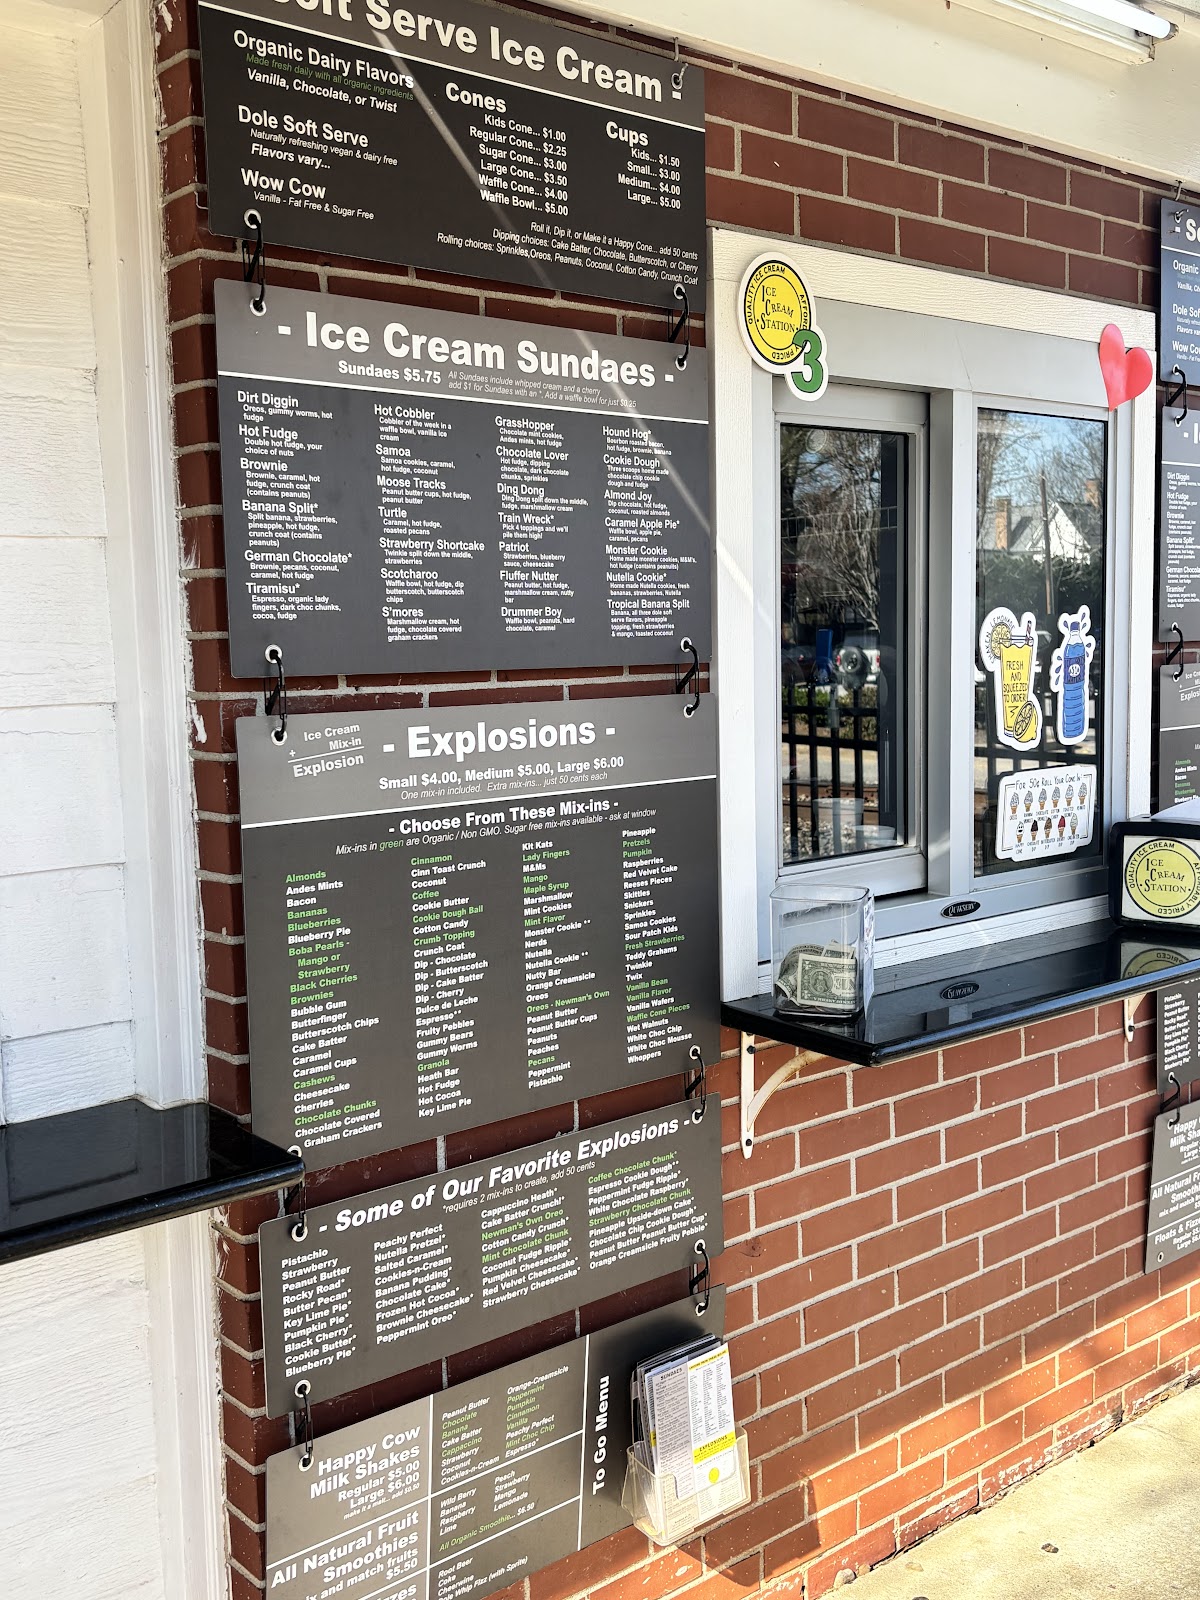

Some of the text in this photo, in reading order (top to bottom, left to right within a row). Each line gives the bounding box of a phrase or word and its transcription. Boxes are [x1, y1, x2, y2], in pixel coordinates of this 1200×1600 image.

[234, 30, 414, 88] Organic Dairy Flavors
[366, 0, 661, 102] Serve Ice Cream
[446, 82, 506, 113] Cones
[238, 105, 368, 147] Dole Soft Serve
[485, 114, 566, 142] Kids Cone... $1.00
[606, 121, 648, 147] Cups
[251, 128, 398, 166] Naturally refreshing vegan & dairy free
[631, 148, 680, 167] Kids... $1.50
[241, 168, 326, 199] Wow Cow
[493, 228, 520, 244] Dipping
[521, 234, 549, 247] choices:
[551, 239, 569, 250] Cake
[570, 242, 591, 255] Batter,
[593, 246, 627, 261] Chocolate,
[629, 252, 668, 268] Butterscotch,
[678, 261, 698, 274] Cherry
[1173, 260, 1199, 275] Organic
[762, 285, 776, 302] ICE
[766, 299, 794, 318] CREAM
[1172, 304, 1188, 316] Dole
[761, 313, 795, 333] STATION
[306, 311, 655, 387] Ice Cream Sundaes
[1172, 341, 1189, 353] Wow
[791, 329, 823, 393] 3
[338, 360, 441, 384] Sundaes $5.75
[238, 391, 298, 408] Dirt Diggin
[243, 404, 332, 419] Oreos, gummy worms, hot
[239, 424, 298, 441] Hot Fudge
[495, 416, 554, 432] GrassHopper
[376, 444, 411, 457] Samoa
[496, 445, 569, 460] Chocolate Lover
[240, 458, 288, 472] Brownie
[377, 475, 446, 489] Moose Tracks
[378, 506, 407, 518] Turtle
[379, 537, 484, 551] Strawberry Shortcake
[500, 570, 559, 581] Fluffer Nutter
[1006, 661, 1024, 670] FRESH
[1011, 672, 1021, 681] AND
[304, 724, 360, 741] Ice Cream
[408, 719, 595, 762] Explosions
[329, 737, 362, 750] Mix-in
[293, 755, 364, 777] Explosion
[379, 756, 624, 789] Small $4.00, Medium $5.00, Large $6.00
[400, 799, 610, 834] Choose From These Mix-ins
[622, 827, 656, 837] Pineapple
[623, 838, 650, 847] Pretzels
[1136, 848, 1148, 858] ICE
[1149, 842, 1175, 850] CREAM
[1146, 859, 1164, 871] ICE
[286, 870, 326, 883] Almonds
[412, 877, 446, 889] Coconut
[1150, 869, 1184, 881] CREAM
[412, 890, 439, 900] Coffee
[524, 882, 569, 894] Maple Syrup
[1144, 879, 1187, 893] STATION
[287, 897, 316, 907] Bacon
[418, 1059, 449, 1071] Granola
[294, 1083, 350, 1102] Cheesecake
[419, 1098, 471, 1117] Key Lime Pie
[1174, 1119, 1197, 1134] Happy
[1170, 1135, 1186, 1148] Milk
[335, 1119, 678, 1231] Some of Our Favorite Explosions
[1152, 1175, 1192, 1200] All Natural
[482, 1209, 563, 1240] Newman's Own Oreo
[1154, 1228, 1176, 1245] Floats
[282, 1249, 328, 1268] Pistachio
[282, 1258, 338, 1280] Strawberry
[375, 1257, 451, 1286] Cookies-n-Cream
[592, 1375, 610, 1495] To Go Menu
[318, 1426, 420, 1476] Happy Cow
[311, 1446, 420, 1499] Milk Shakes
[338, 1460, 420, 1502] Regular $5.00
[271, 1510, 419, 1588] All Natural Fruit
[323, 1532, 418, 1582] Smoothies
[386, 1558, 418, 1580] $5.50
